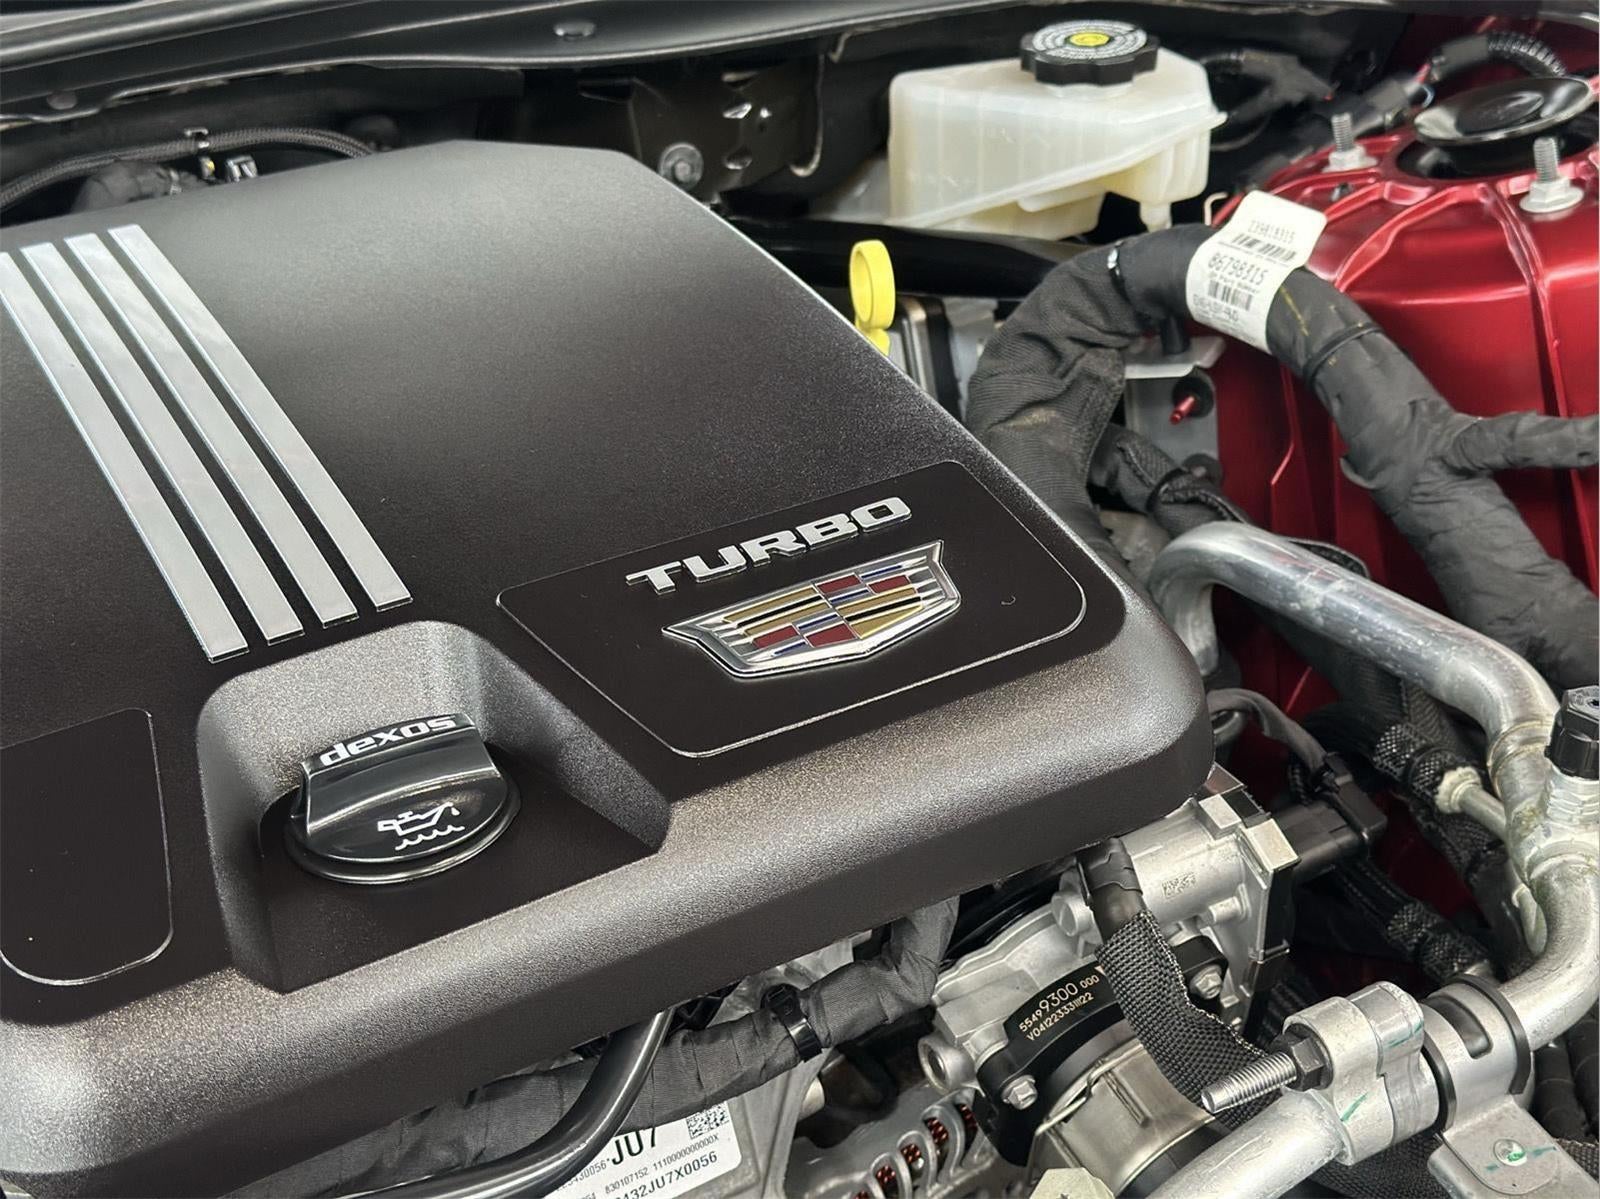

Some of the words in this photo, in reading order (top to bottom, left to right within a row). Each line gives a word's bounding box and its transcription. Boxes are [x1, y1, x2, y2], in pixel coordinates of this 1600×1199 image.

[625, 496, 912, 595] TURBO
[319, 715, 457, 767] dexos
[1079, 974, 1100, 989] 000
